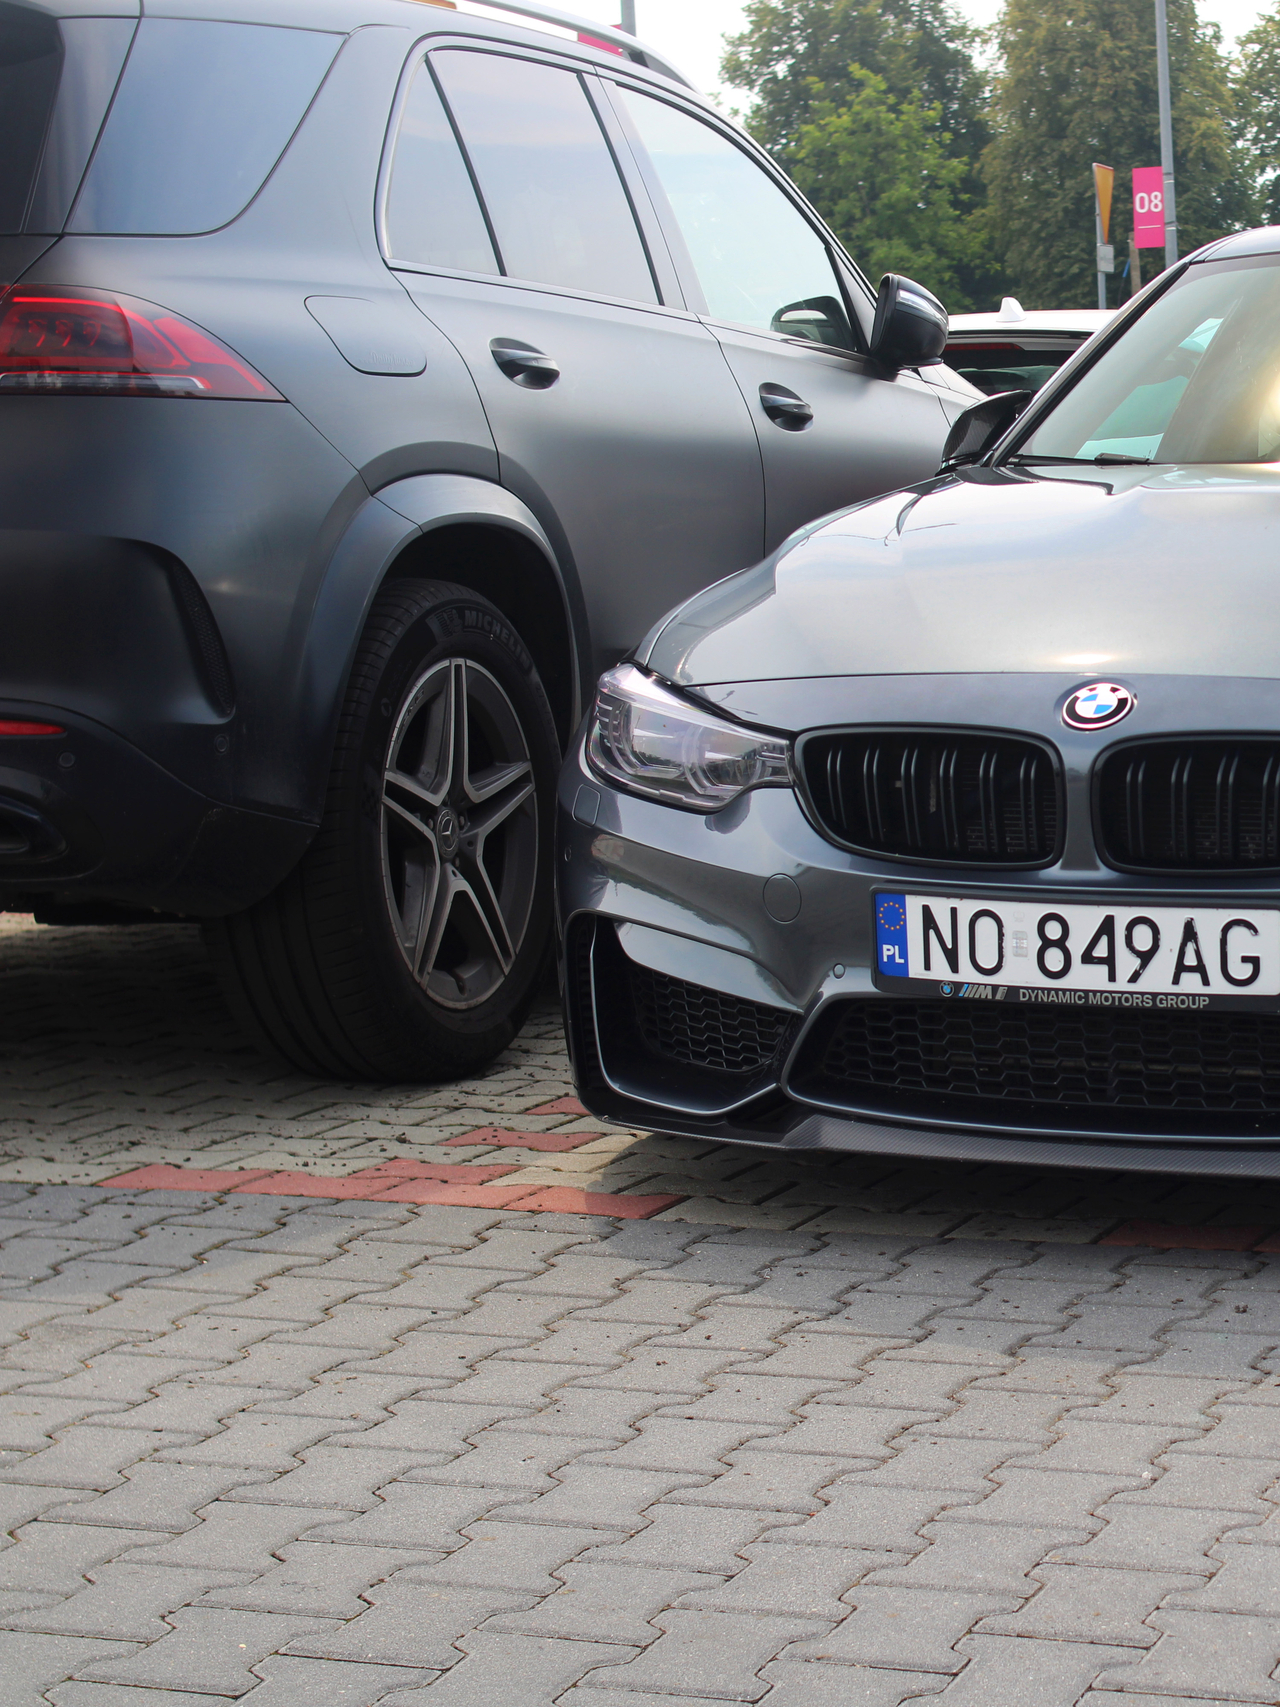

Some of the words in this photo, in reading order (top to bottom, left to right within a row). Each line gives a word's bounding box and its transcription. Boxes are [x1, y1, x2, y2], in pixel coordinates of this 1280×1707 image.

[1135, 191, 1163, 213] 08
[464, 609, 531, 670] MICHELIN
[882, 943, 905, 965] PL
[921, 902, 1006, 976] NO
[1035, 911, 1261, 987] 849AG
[1019, 989, 1085, 1004] DYNAMIC
[1088, 992, 1153, 1008] MOTORS
[1156, 995, 1210, 1009] GROUP
